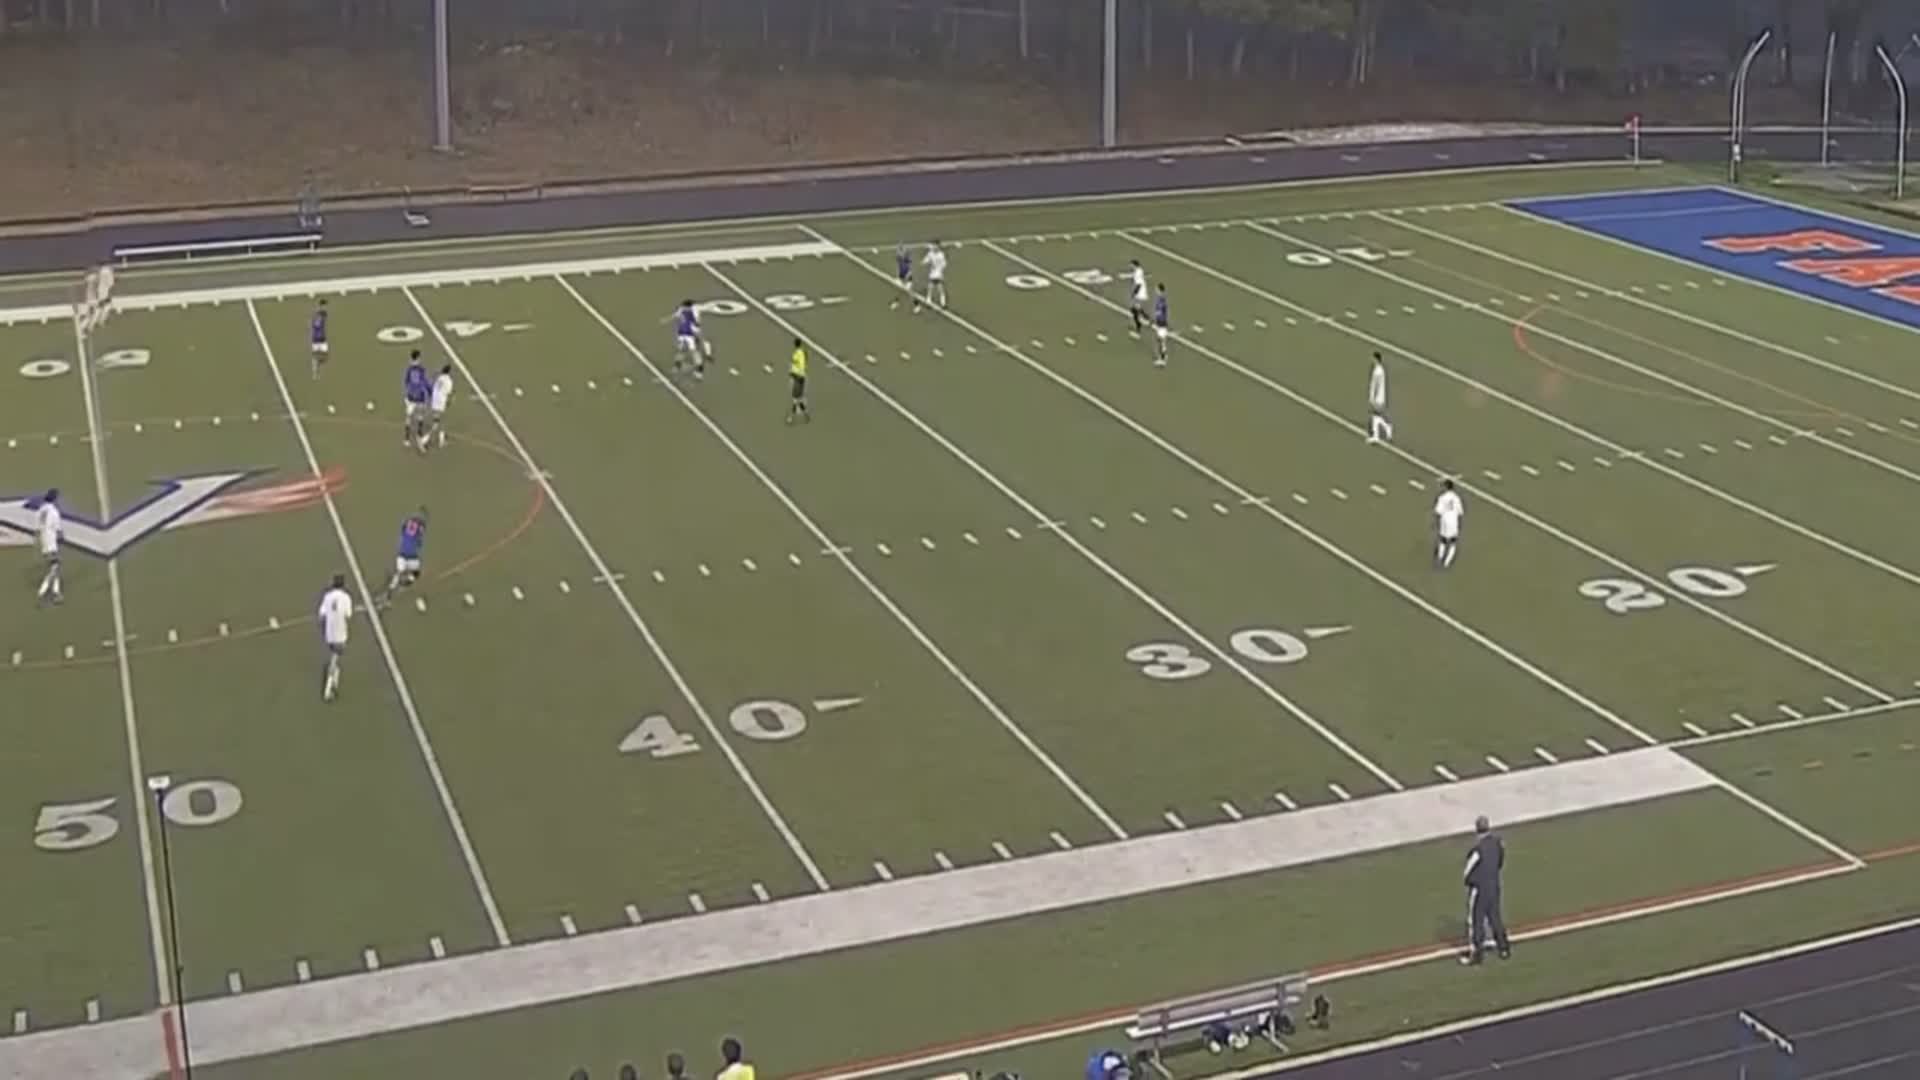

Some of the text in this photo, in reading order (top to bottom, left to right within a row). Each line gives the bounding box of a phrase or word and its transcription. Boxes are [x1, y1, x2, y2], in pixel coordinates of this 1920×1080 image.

[1700, 229, 1920, 305] FA
[1578, 567, 1748, 613] 20
[1126, 628, 1308, 680] 30
[618, 700, 807, 758] 40
[34, 780, 242, 850] 50
